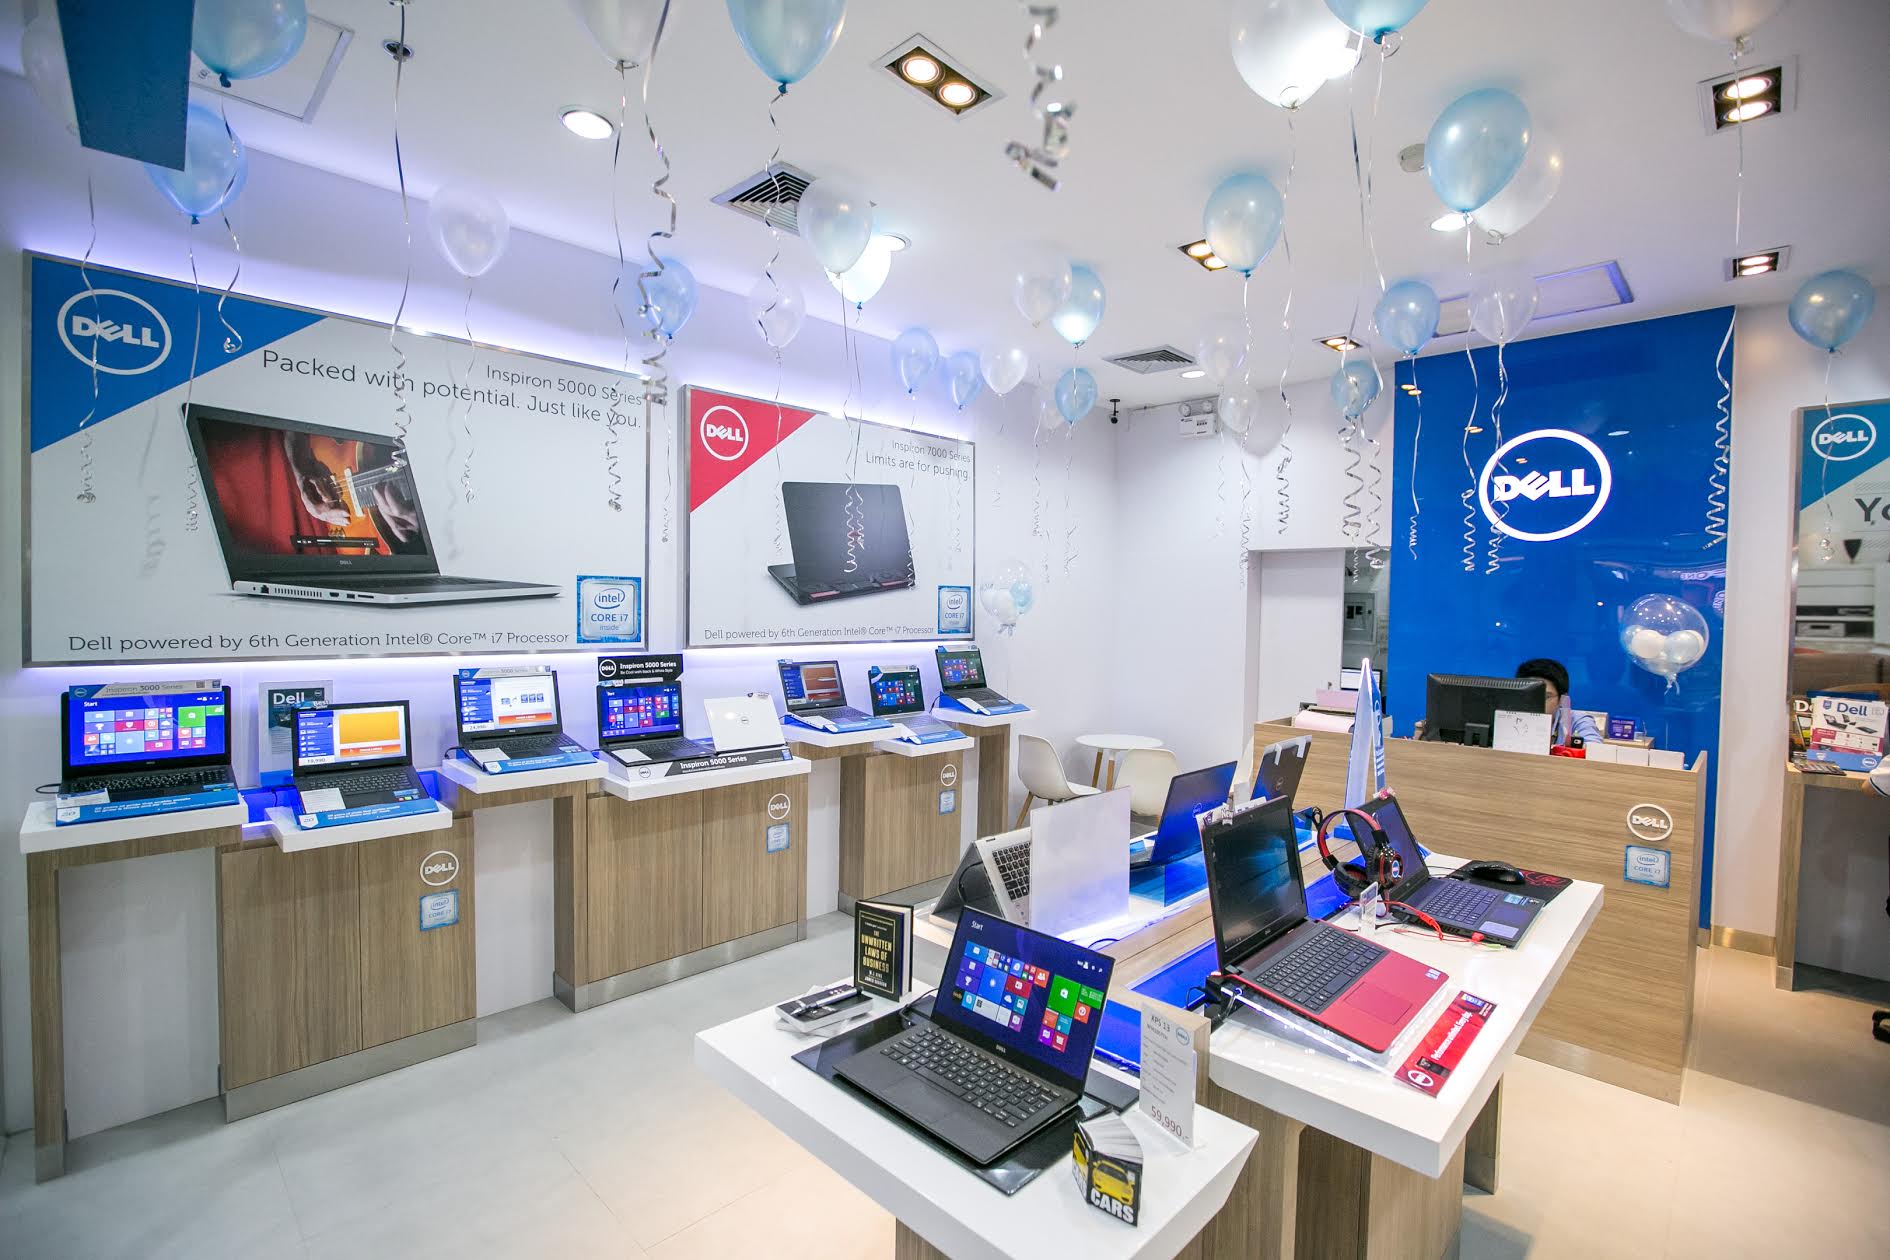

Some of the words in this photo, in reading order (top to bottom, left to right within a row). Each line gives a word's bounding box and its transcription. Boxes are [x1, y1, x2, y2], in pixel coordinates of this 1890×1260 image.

[72, 315, 159, 348] DELL
[263, 349, 356, 382] Packed
[365, 370, 414, 392] with
[423, 381, 520, 409] potential.
[527, 395, 566, 417] Just
[572, 402, 601, 421] like
[606, 410, 641, 428] you.
[487, 365, 552, 390] Inspiron
[557, 378, 597, 397] 5000
[601, 386, 642, 406] Series
[706, 423, 744, 442] DELL
[1818, 430, 1869, 445] DELL
[892, 440, 925, 455] Inspiron
[927, 446, 948, 459] 7000
[949, 451, 971, 463] Series
[866, 451, 896, 467] Limits
[899, 459, 915, 470] are
[917, 461, 931, 472] for
[1493, 467, 1595, 501] DELL
[598, 592, 621, 603] intel
[949, 597, 961, 605] intel
[591, 613, 617, 622] CORE
[620, 613, 629, 622] i7
[704, 628, 723, 640] Dell
[725, 628, 767, 640] powered
[768, 628, 779, 640] by
[781, 627, 796, 638] 6th
[797, 627, 841, 638] Generation
[902, 626, 934, 635] Processor
[68, 635, 113, 651] Dell
[120, 635, 213, 653] powered
[219, 634, 243, 652] by
[249, 634, 279, 648] 6th
[285, 633, 380, 647] Generation
[385, 632, 433, 646] Intel®
[437, 632, 487, 645] Core™
[491, 632, 504, 644] i7
[507, 632, 569, 644] Processor
[620, 662, 644, 670] Inspiron
[273, 692, 305, 705] Dell
[1836, 702, 1868, 716] Dell
[680, 760, 709, 770] Inspiron
[710, 757, 727, 766] 5000
[728, 755, 748, 764] Series
[770, 801, 788, 811] DELL
[1632, 815, 1668, 829] DELL
[424, 862, 455, 875] DELL
[971, 920, 984, 931] Start
[861, 933, 892, 952] UNWRITTEN
[864, 946, 880, 959] LAWS
[880, 951, 888, 961] OF
[862, 956, 890, 973] BUSINESS
[1151, 1015, 1161, 1027] XPS
[1163, 1021, 1170, 1032] 13
[1090, 1187, 1134, 1224] CARS
